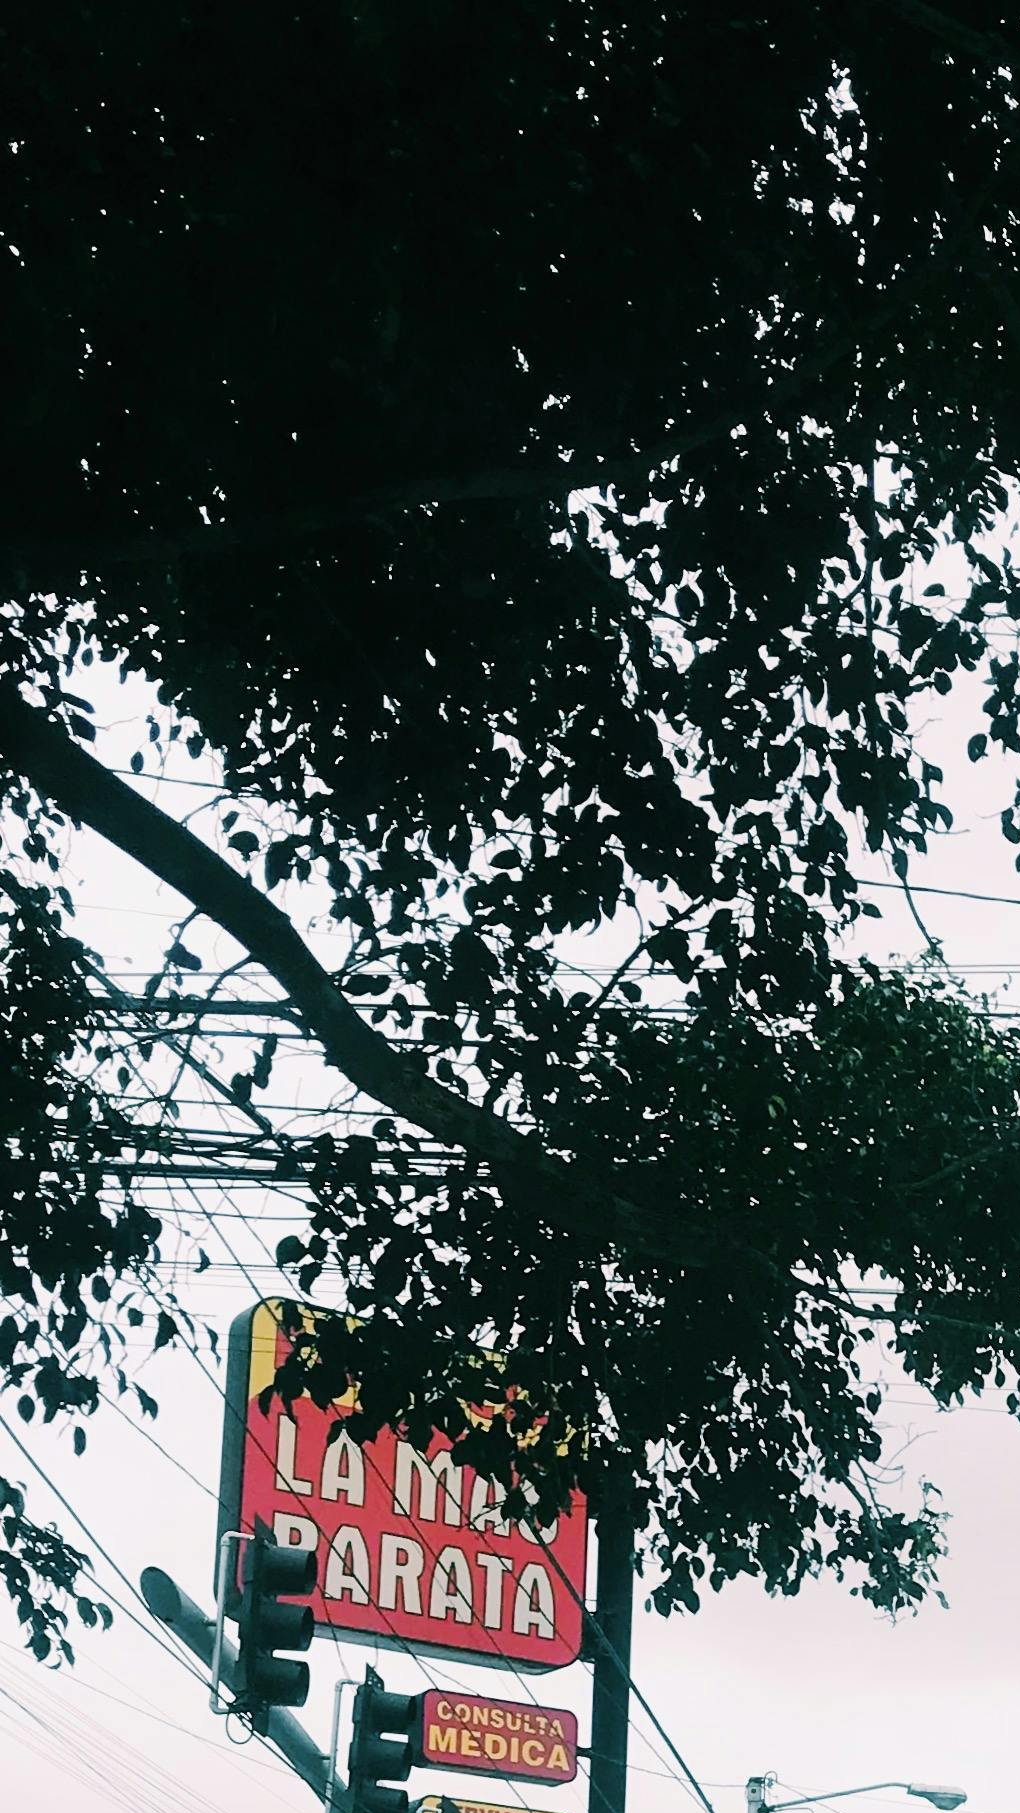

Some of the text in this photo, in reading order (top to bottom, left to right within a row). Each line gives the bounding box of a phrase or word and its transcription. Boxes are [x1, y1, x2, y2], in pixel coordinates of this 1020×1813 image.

[275, 1414, 366, 1507] LA
[436, 1700, 565, 1739] CONSULTA
[428, 1724, 570, 1772] MEDICA
